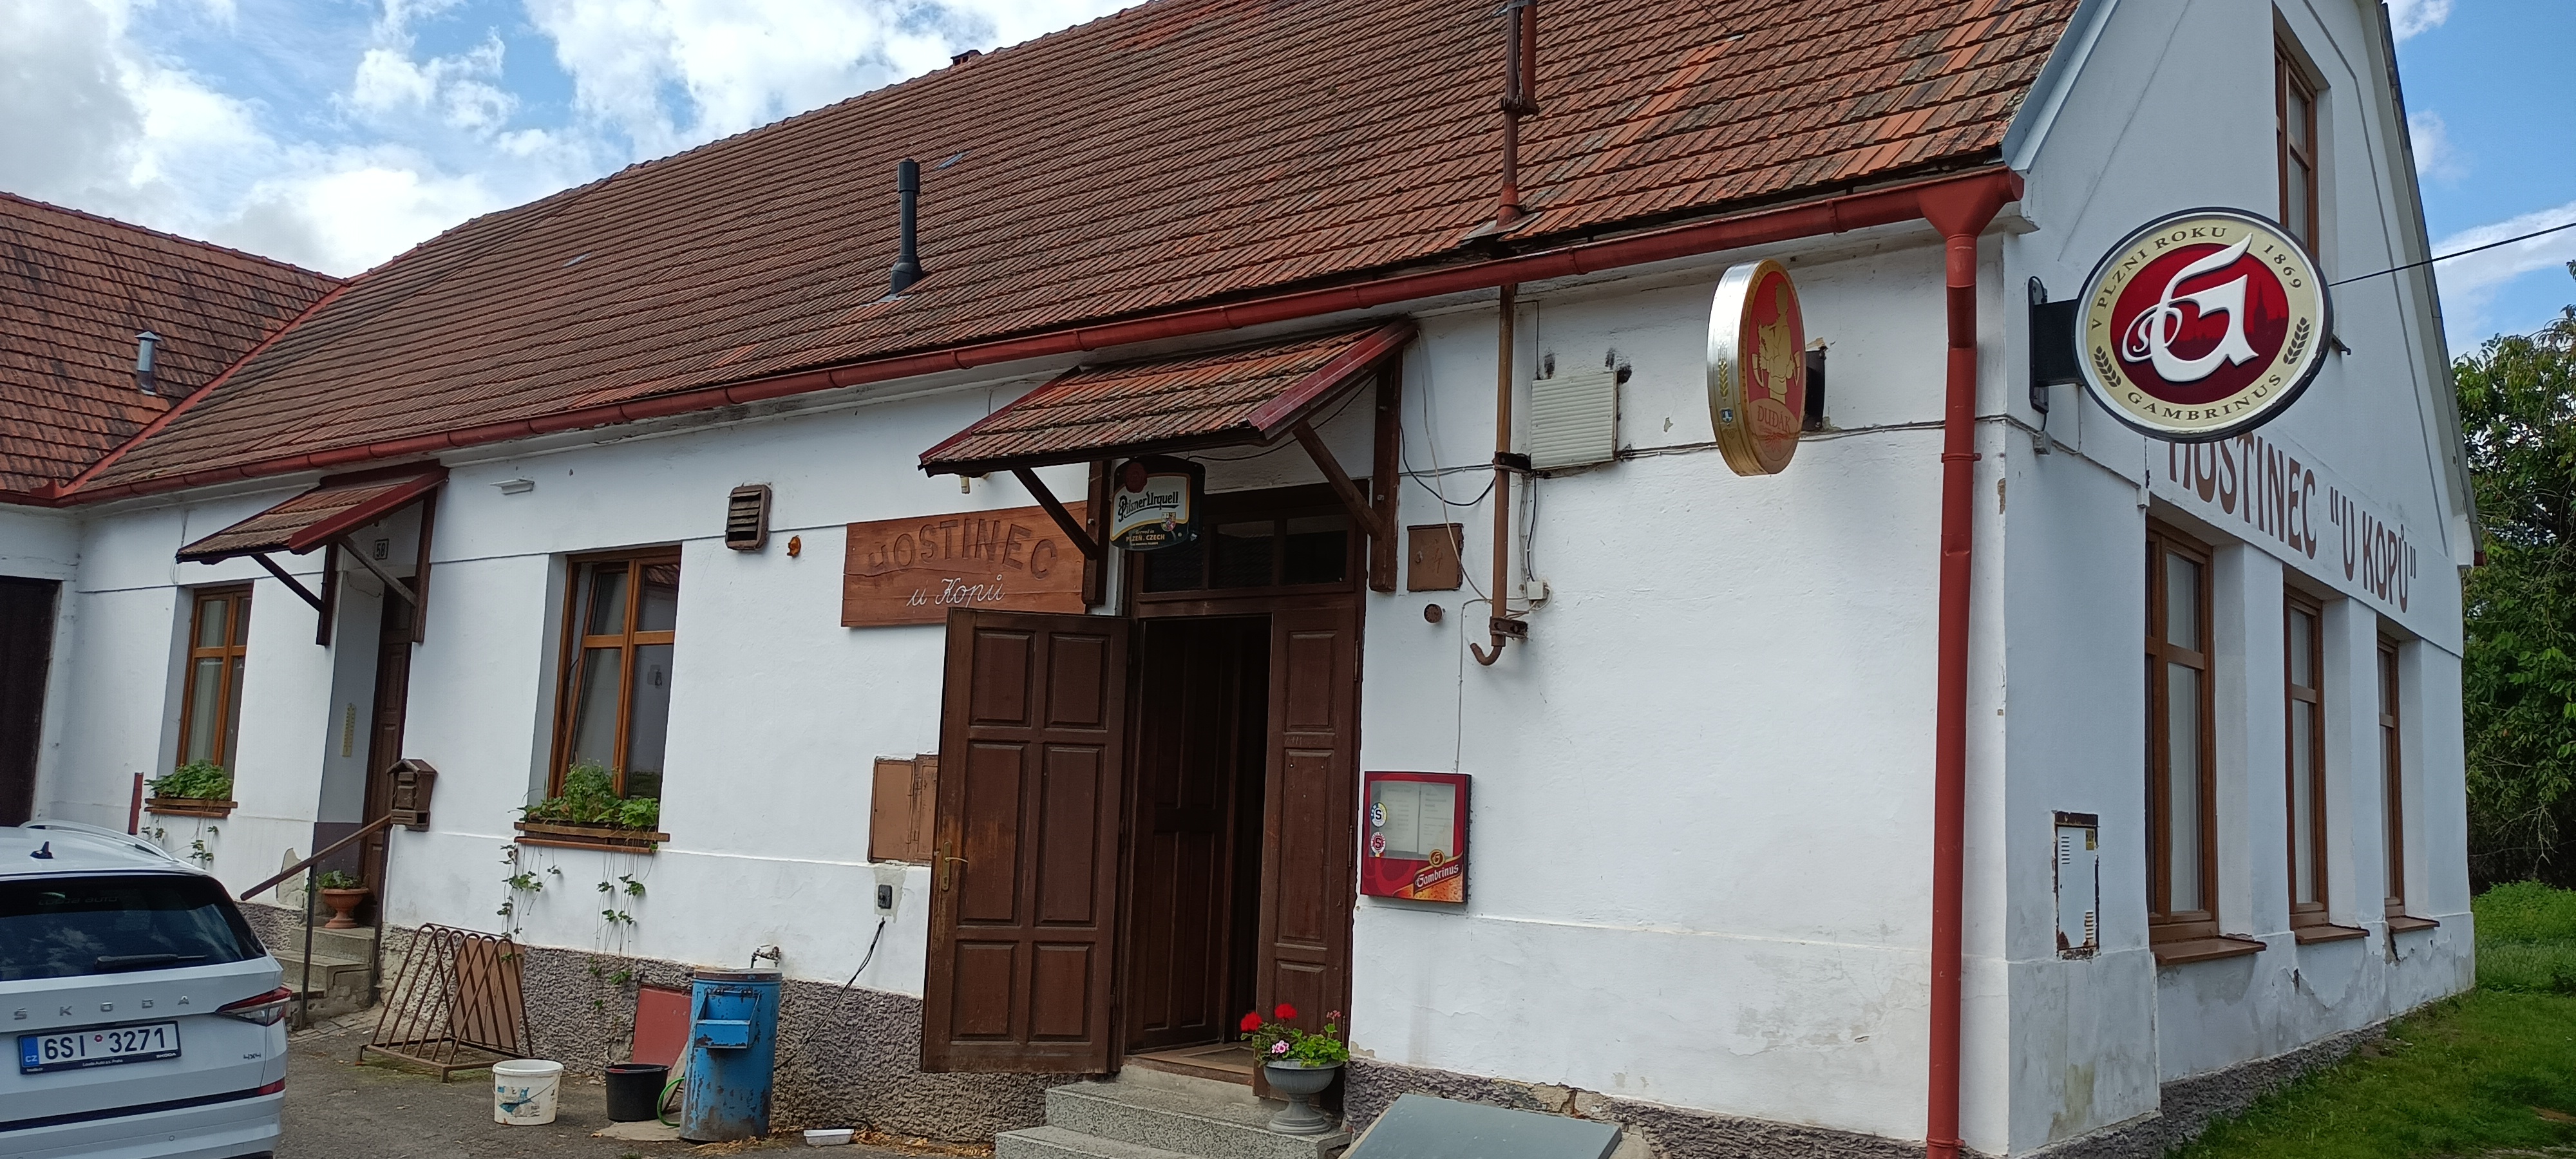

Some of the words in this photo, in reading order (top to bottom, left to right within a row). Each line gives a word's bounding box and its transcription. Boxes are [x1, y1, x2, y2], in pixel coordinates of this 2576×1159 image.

[2154, 227, 2228, 250] ROKU
[2096, 249, 2148, 310] PLZNI
[2263, 244, 2302, 288] 1869
[2091, 318, 2103, 331] V
[2127, 373, 2281, 420] GAMBRINUS
[1757, 405, 1792, 433] DUDÁK
[1118, 495, 1148, 523] Pilsner
[1146, 491, 1179, 510] Urquell
[376, 542, 386, 558] 58
[867, 517, 1058, 580] HOSTINEC
[934, 574, 1006, 608] Kopů
[1415, 864, 1459, 887] Gambrinus
[44, 1035, 86, 1060] 6SI
[109, 1027, 166, 1053] 3271
